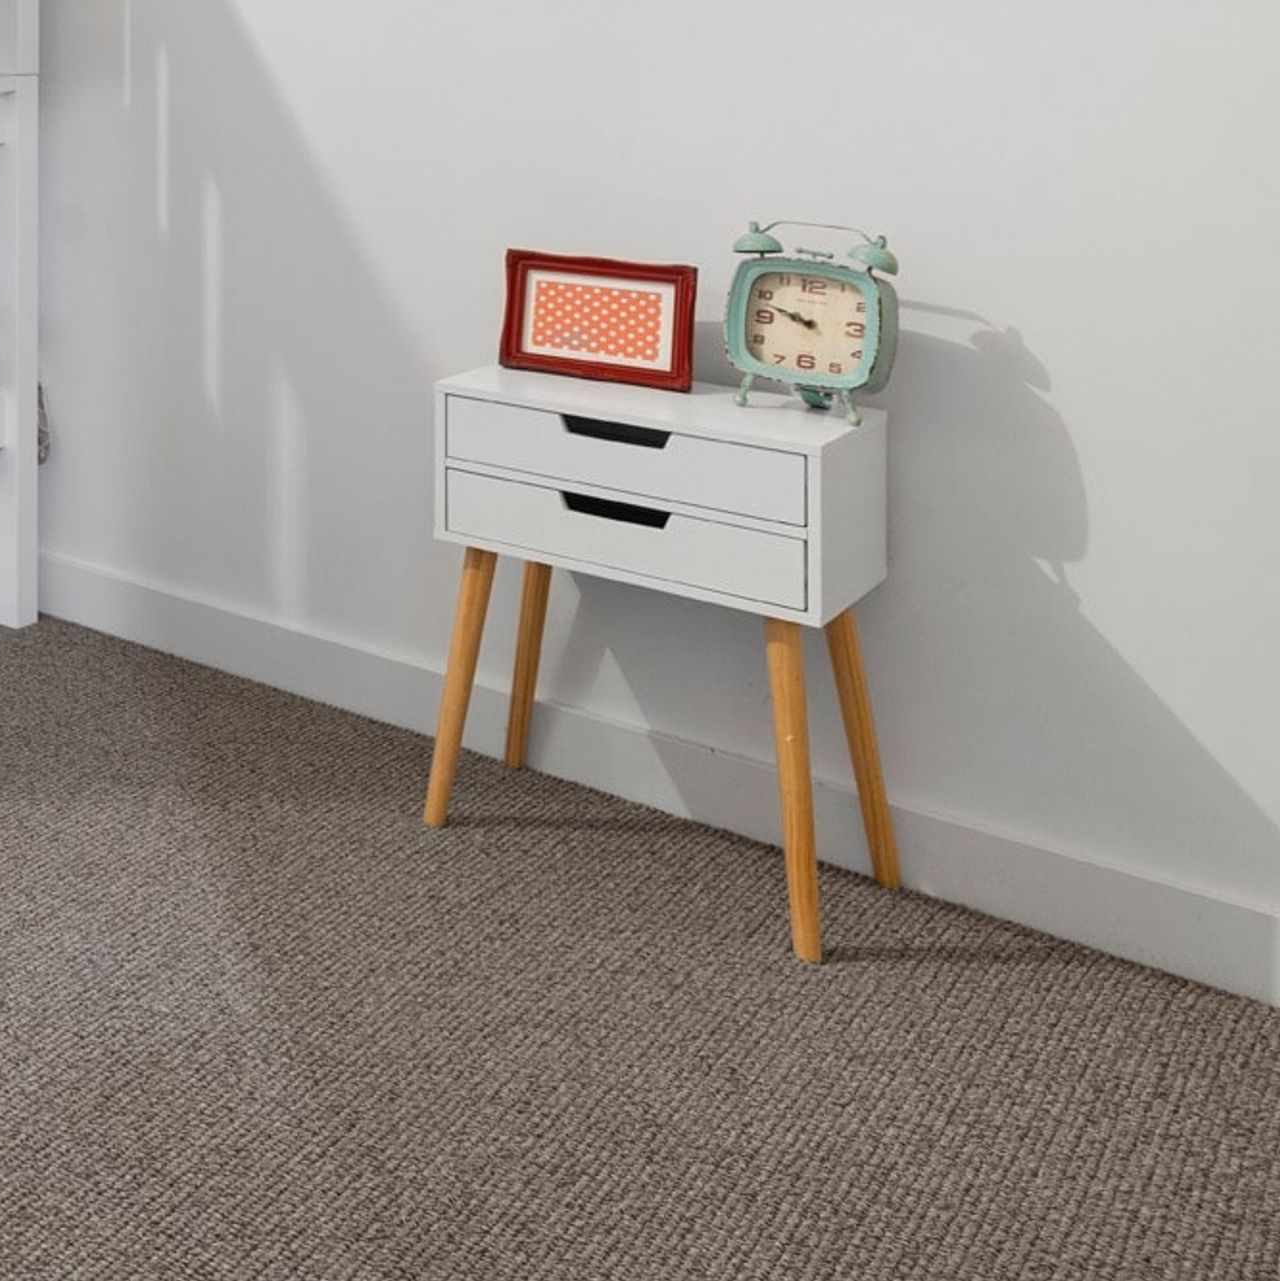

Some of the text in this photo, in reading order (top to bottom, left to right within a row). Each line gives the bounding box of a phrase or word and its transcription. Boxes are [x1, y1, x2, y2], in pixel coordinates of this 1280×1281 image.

[801, 279, 827, 295] 12
[757, 290, 774, 301] 10
[755, 309, 775, 325] 9
[845, 322, 866, 338] 3
[773, 354, 786, 365] 7
[796, 354, 817, 370] 6
